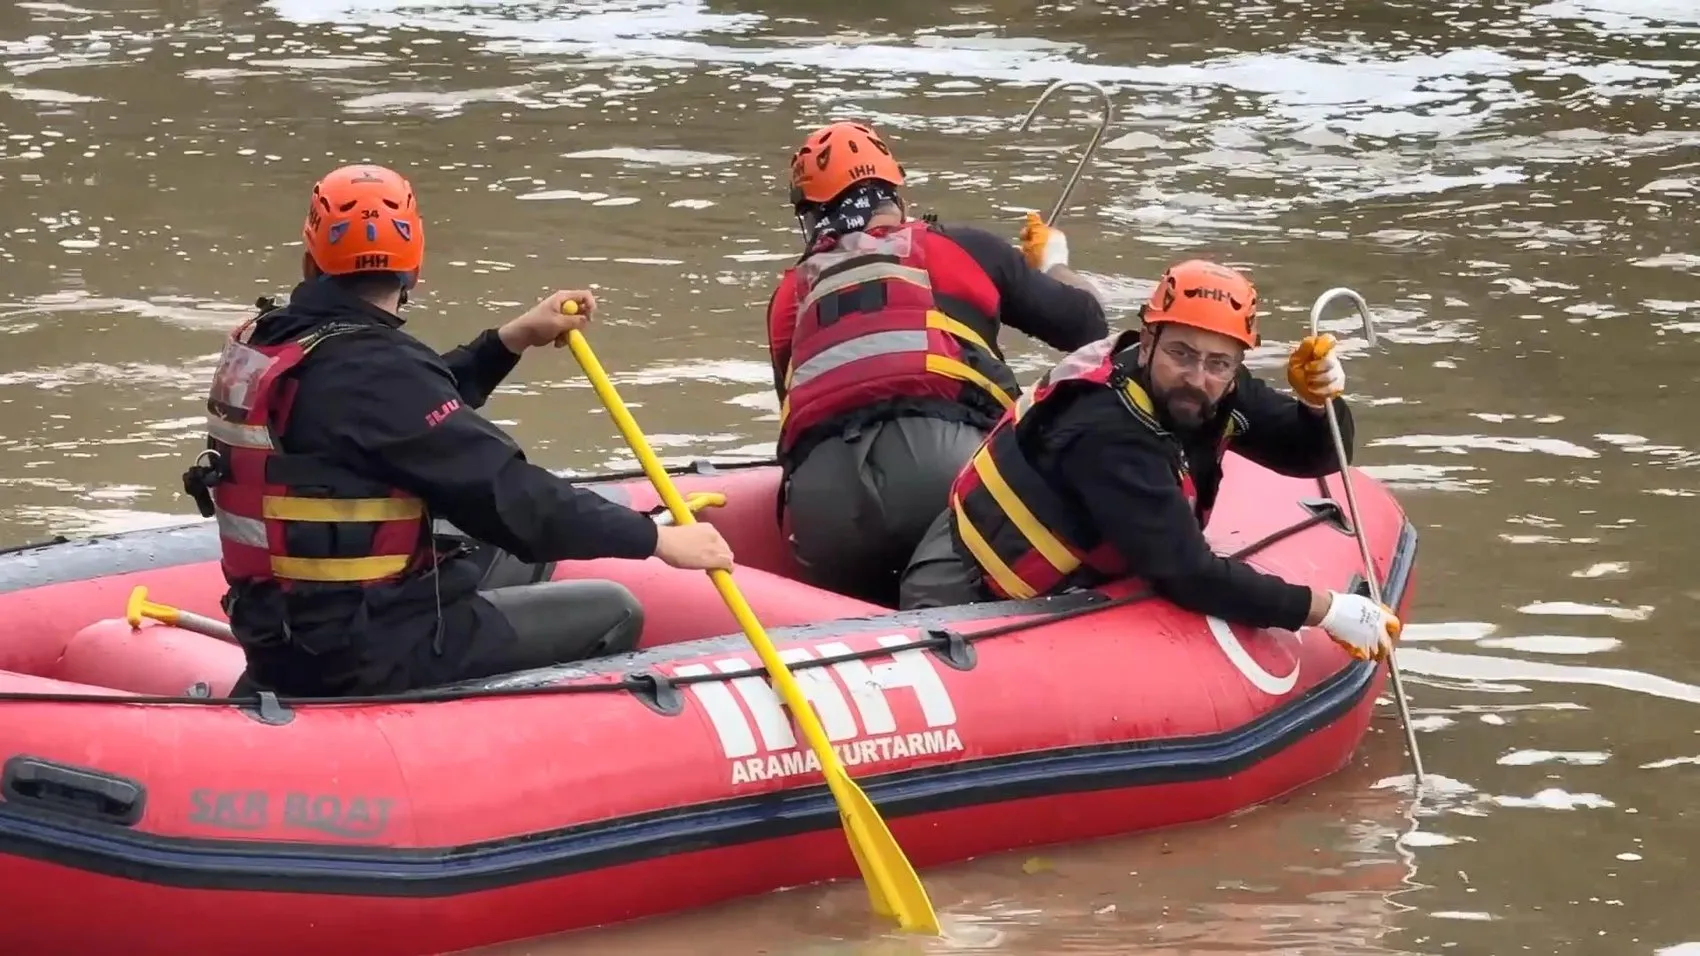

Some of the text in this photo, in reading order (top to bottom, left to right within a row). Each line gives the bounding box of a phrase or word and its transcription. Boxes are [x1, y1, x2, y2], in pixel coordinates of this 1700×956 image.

[361, 209, 379, 219] 34
[731, 748, 822, 785] ARAMA
[283, 790, 397, 838] BOAT
